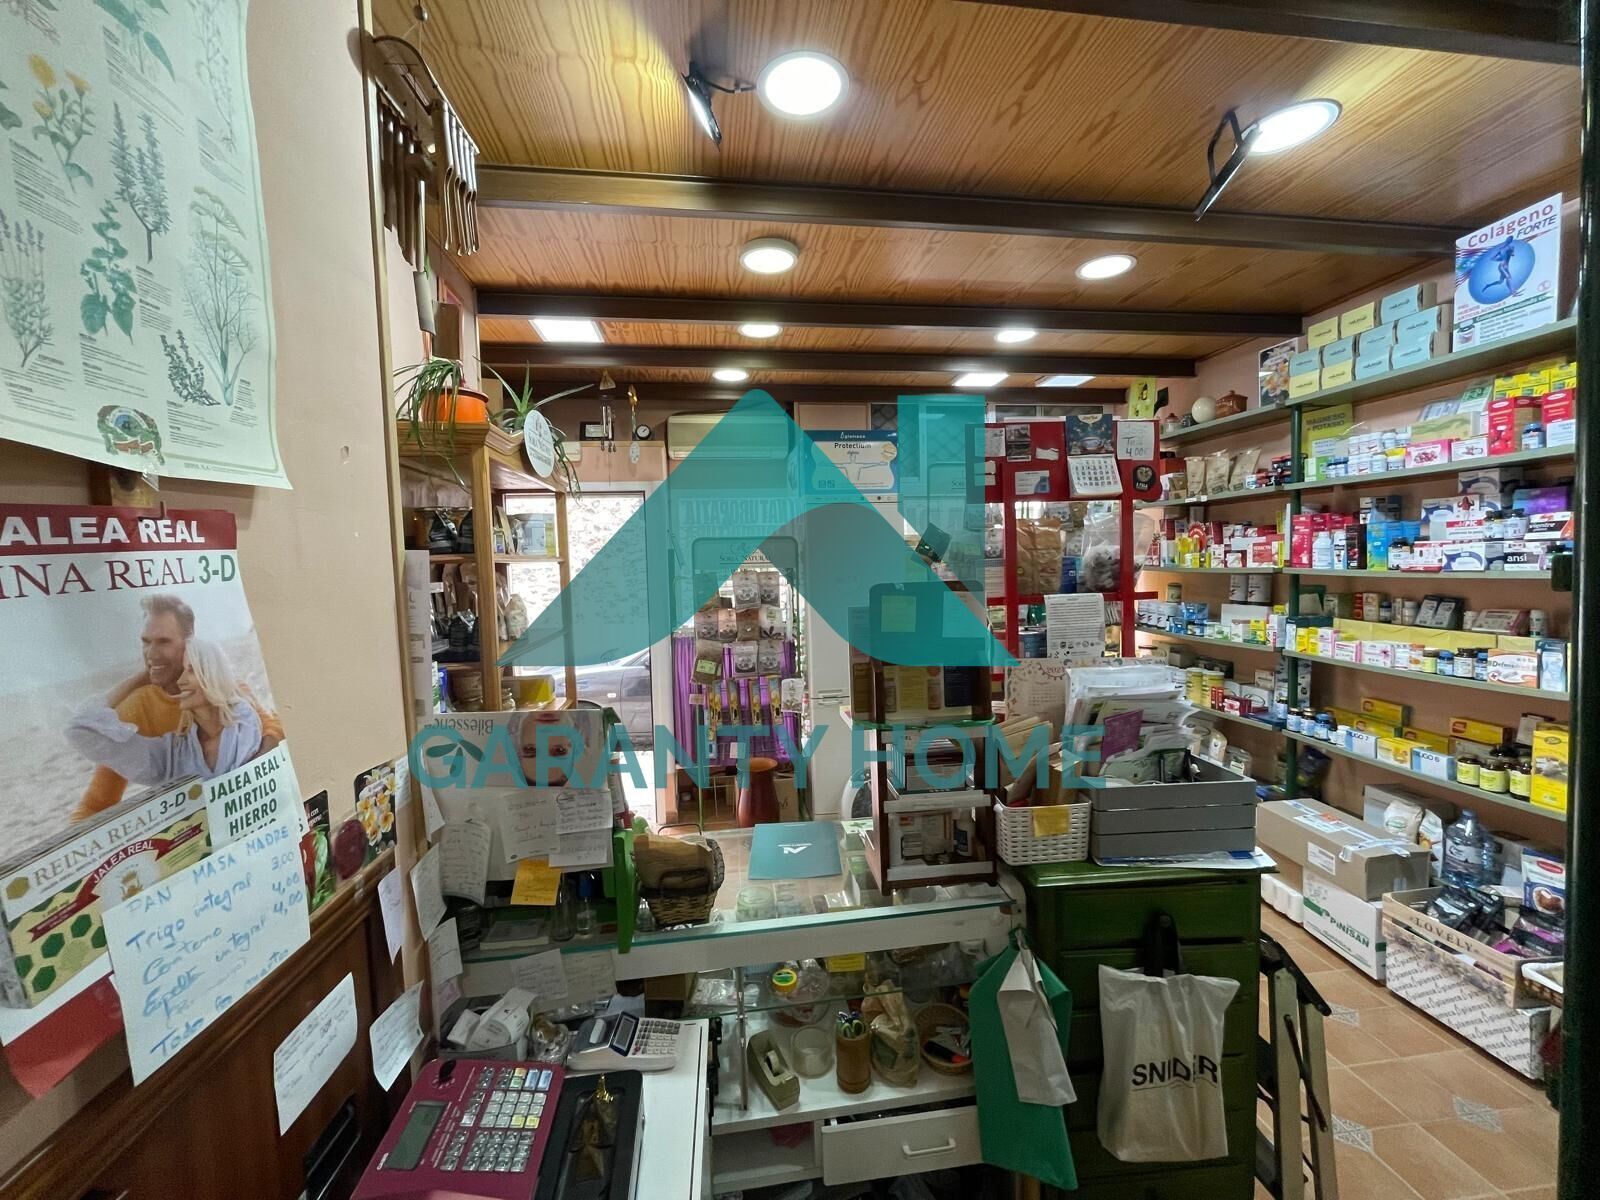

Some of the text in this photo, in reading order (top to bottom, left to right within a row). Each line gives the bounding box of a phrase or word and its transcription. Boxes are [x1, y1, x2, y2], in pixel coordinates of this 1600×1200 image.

[1467, 203, 1554, 248] Colágeno
[1516, 214, 1557, 239] FORTE
[138, 518, 206, 543] REAL
[104, 556, 195, 591] REAL
[198, 554, 236, 584] 3-D
[209, 755, 280, 804] JALEA REAL
[224, 778, 277, 818] MIRTILO
[229, 798, 278, 836] HIERRO
[33, 838, 104, 888] REINA
[108, 808, 158, 846] REAL
[159, 791, 186, 815] 3-D
[193, 853, 238, 885] MASA
[246, 825, 290, 857] MADRE
[93, 839, 154, 884] JALEA REAL
[272, 871, 300, 896] 4,00
[125, 917, 186, 952] Trigo
[194, 871, 252, 918] integral
[214, 915, 267, 963] integral
[1415, 916, 1474, 953] LOVELY
